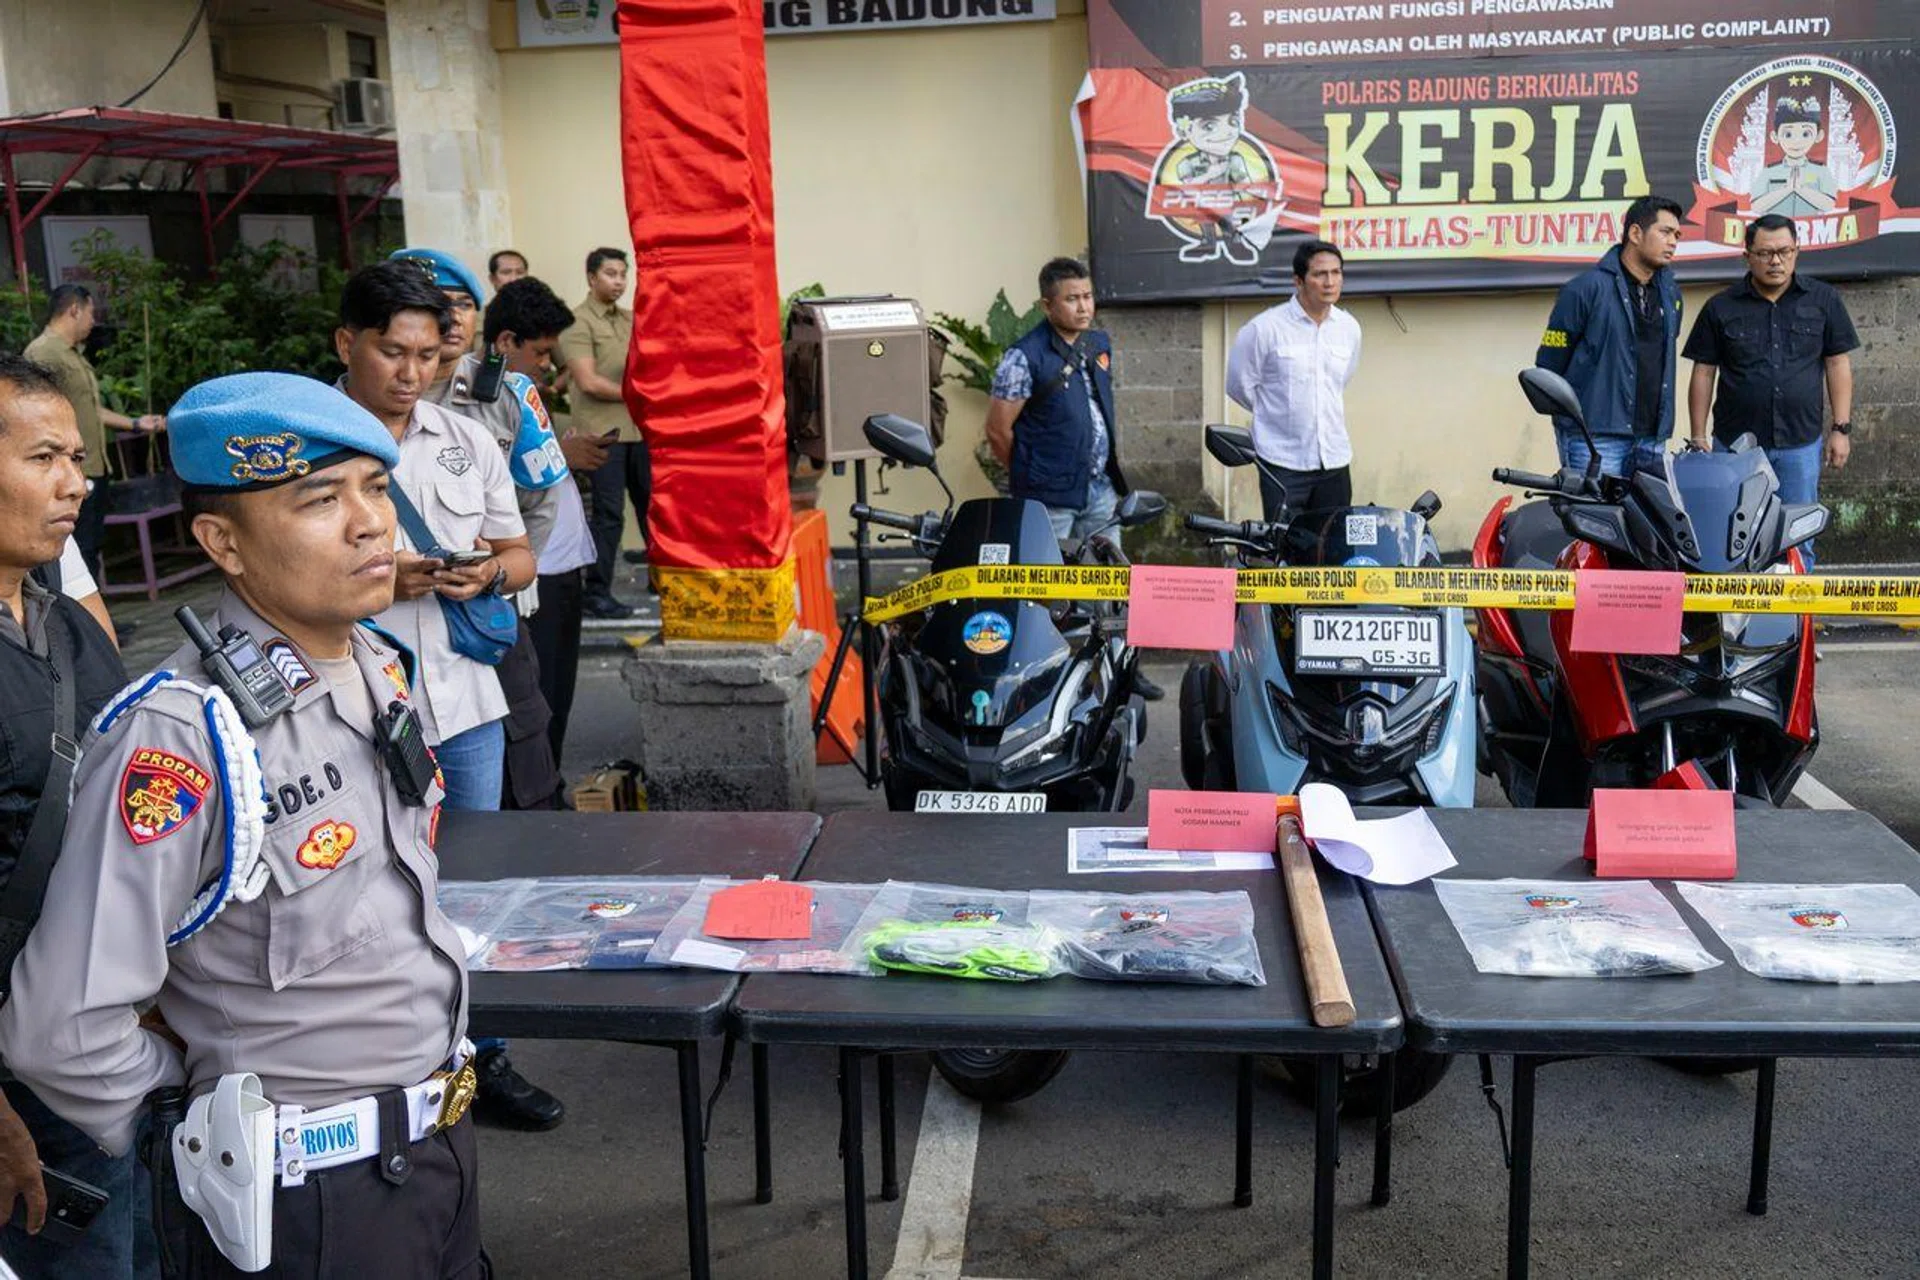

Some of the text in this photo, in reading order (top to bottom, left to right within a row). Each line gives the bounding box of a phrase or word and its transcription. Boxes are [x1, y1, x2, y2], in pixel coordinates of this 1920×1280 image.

[828, 0, 1034, 24] BADUNG
[1229, 0, 1614, 26] 2. PENGUATAN FUNGSI PENGAWASAN
[1230, 17, 1830, 60] 3. PENGAWASAN OLEH MASYARAKAT (PUBLIC COMPLAINT)
[1322, 71, 1638, 105] POLRES BADUNG BERKUALITAS
[1322, 103, 1651, 206] KERJA
[1329, 211, 1628, 249] IKHLAS-TUNTA
[1723, 214, 1859, 246] DRMA
[977, 568, 1026, 585] DILARANG
[1029, 568, 1078, 585] MELINTAS
[1081, 568, 1110, 585] GARIS
[1236, 570, 1356, 588] MELINTAS GARIS POLISI
[1394, 571, 1569, 592] DILARANG MELINTAS GARIS POLISI
[1685, 577, 1712, 595] NTAS
[1715, 578, 1747, 595] GARIS
[1750, 579, 1785, 597] POLISI
[1822, 579, 1875, 597] DILARANG
[1003, 586, 1012, 595] DO
[1013, 586, 1025, 595] NOT
[1027, 586, 1047, 596] CROSS
[1097, 587, 1119, 597] POLICE
[1235, 589, 1345, 600] CROSS POLICE LINE
[1422, 593, 1557, 606] DO NOT CROSS POLICE LINE
[1732, 599, 1898, 612] POLICE LINE DO NOT CROSS
[1307, 661, 1337, 669] YAMAHA
[138, 751, 207, 788] PROPAM
[323, 762, 343, 791] D
[918, 793, 942, 809] DK
[951, 794, 999, 812] 5346
[301, 1121, 355, 1155] ROVOS
